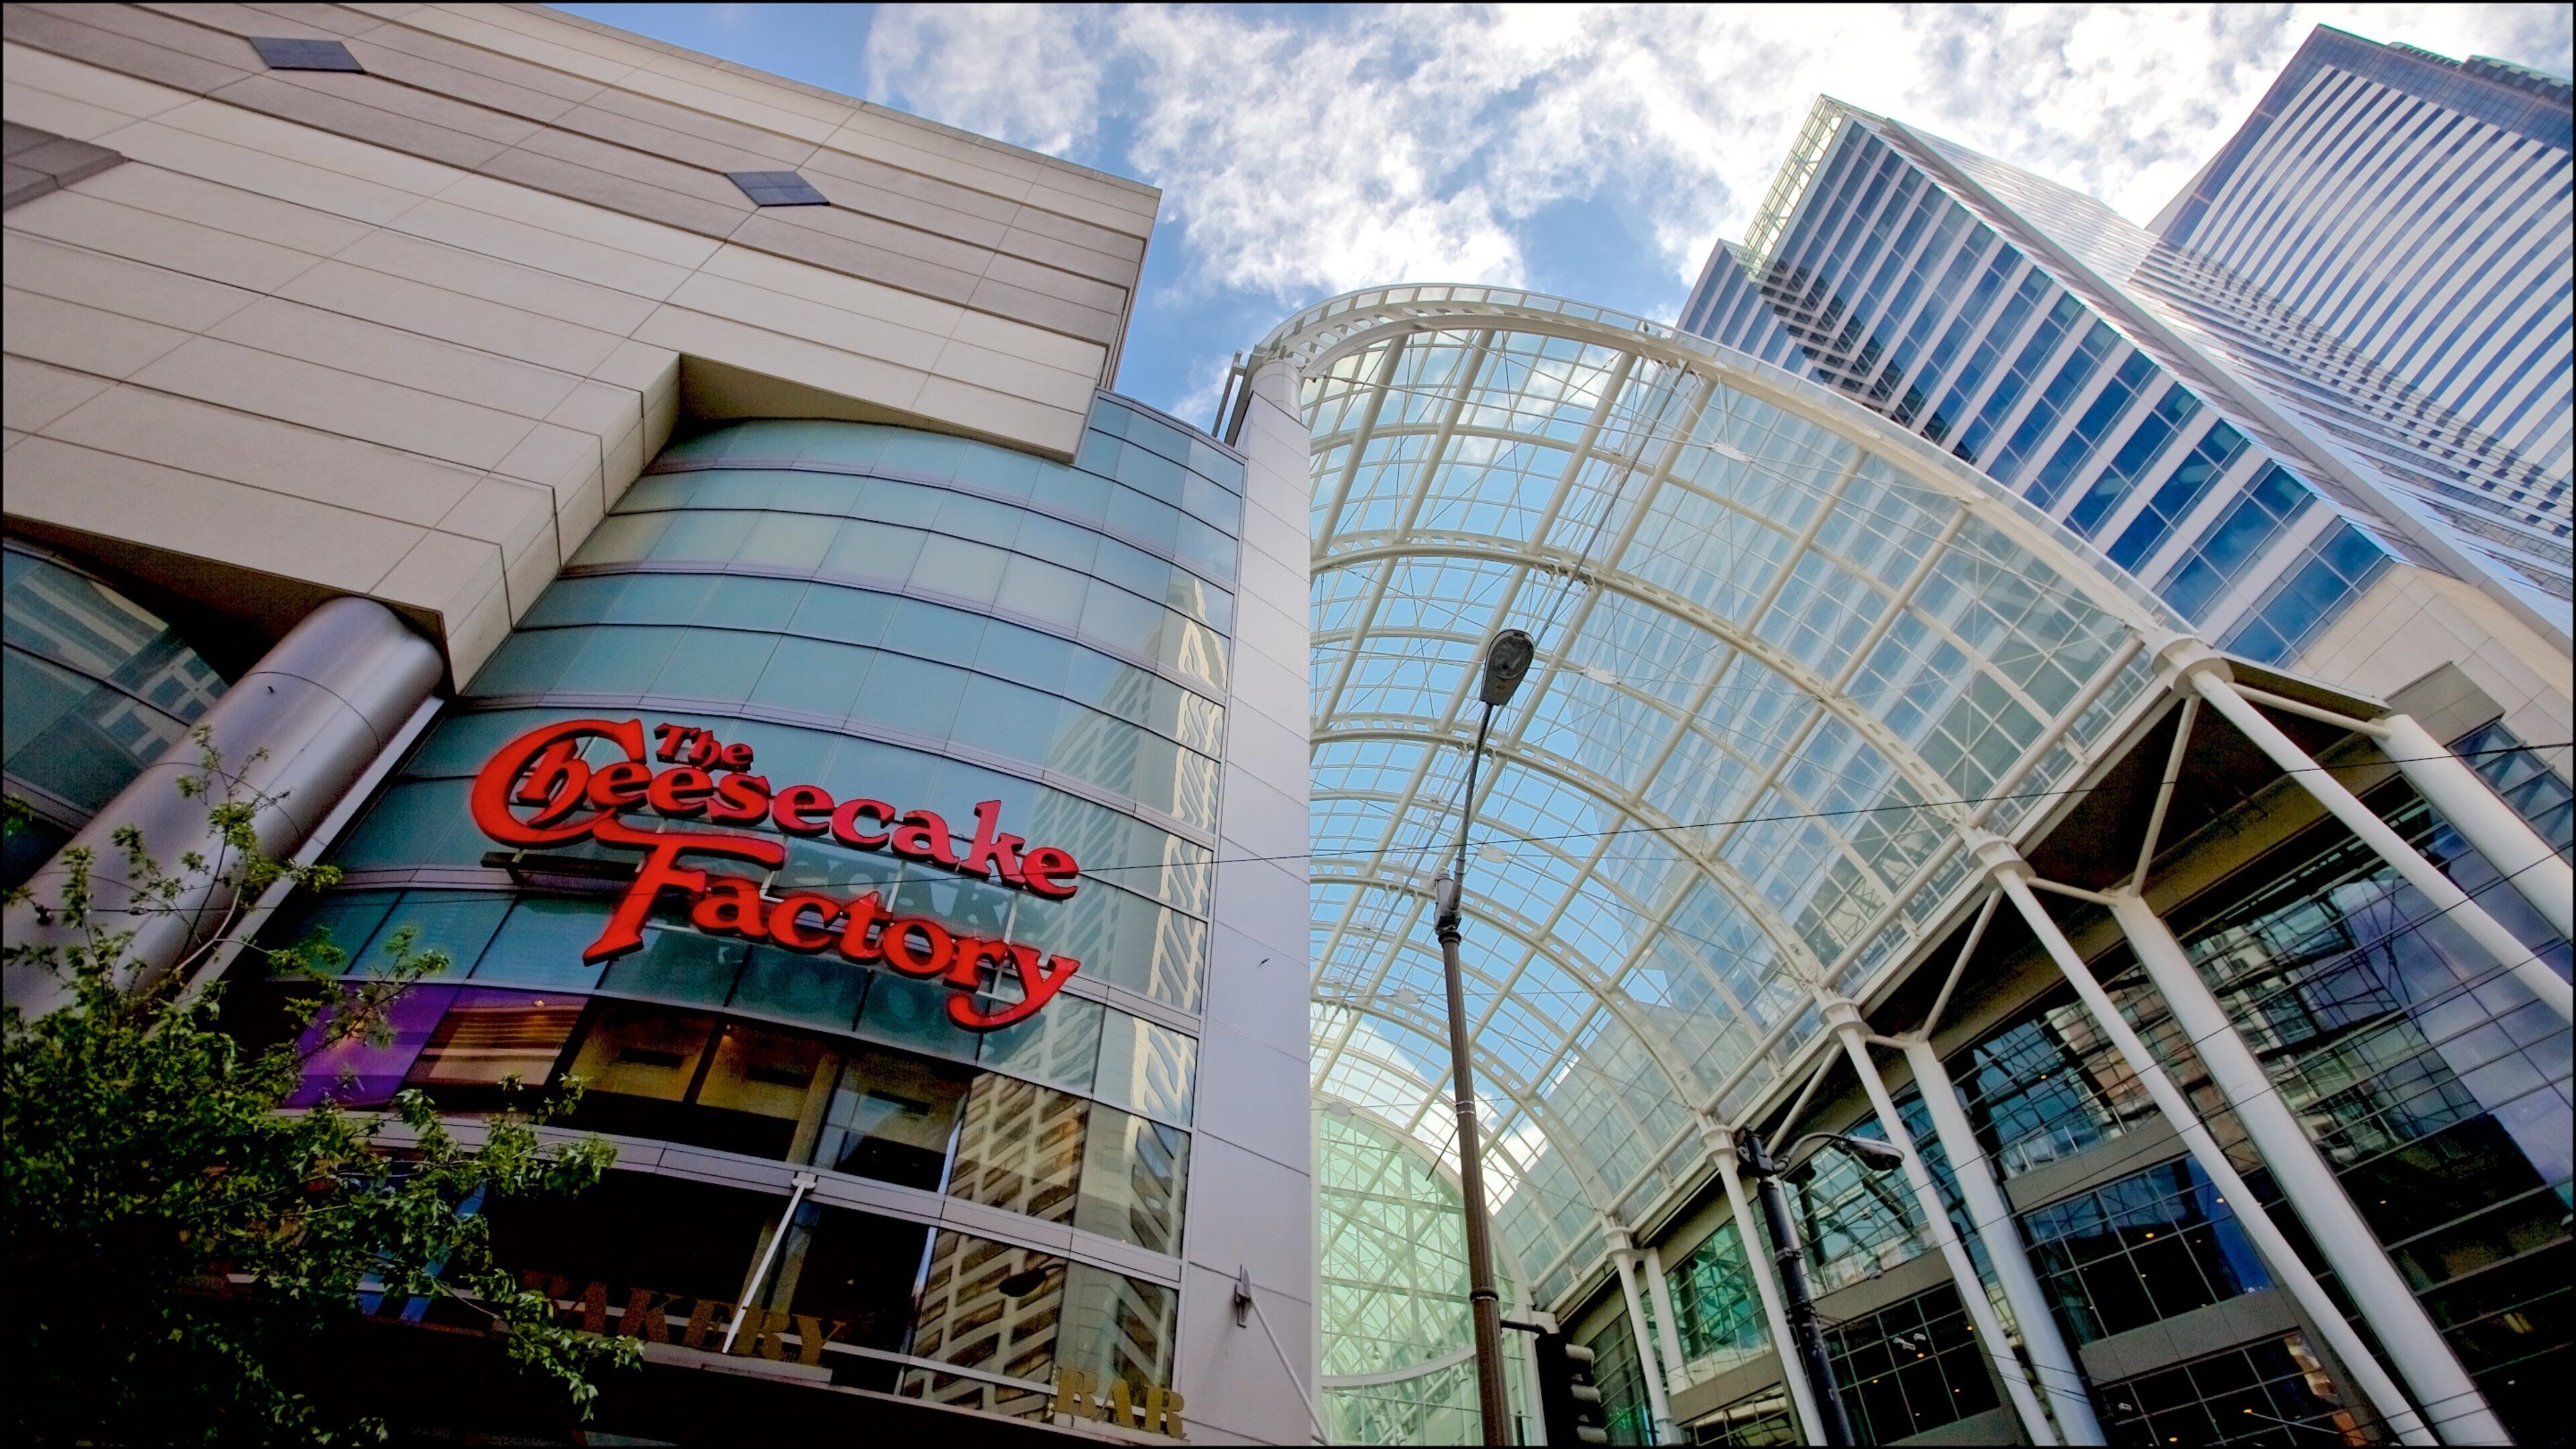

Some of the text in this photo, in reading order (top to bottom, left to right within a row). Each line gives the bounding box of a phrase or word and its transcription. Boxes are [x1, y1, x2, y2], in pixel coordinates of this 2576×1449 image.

[470, 718, 1080, 901] Cheesecake
[655, 722, 754, 773] The
[582, 809, 1081, 1033] Factory
[1053, 1364, 1187, 1440] BAR
